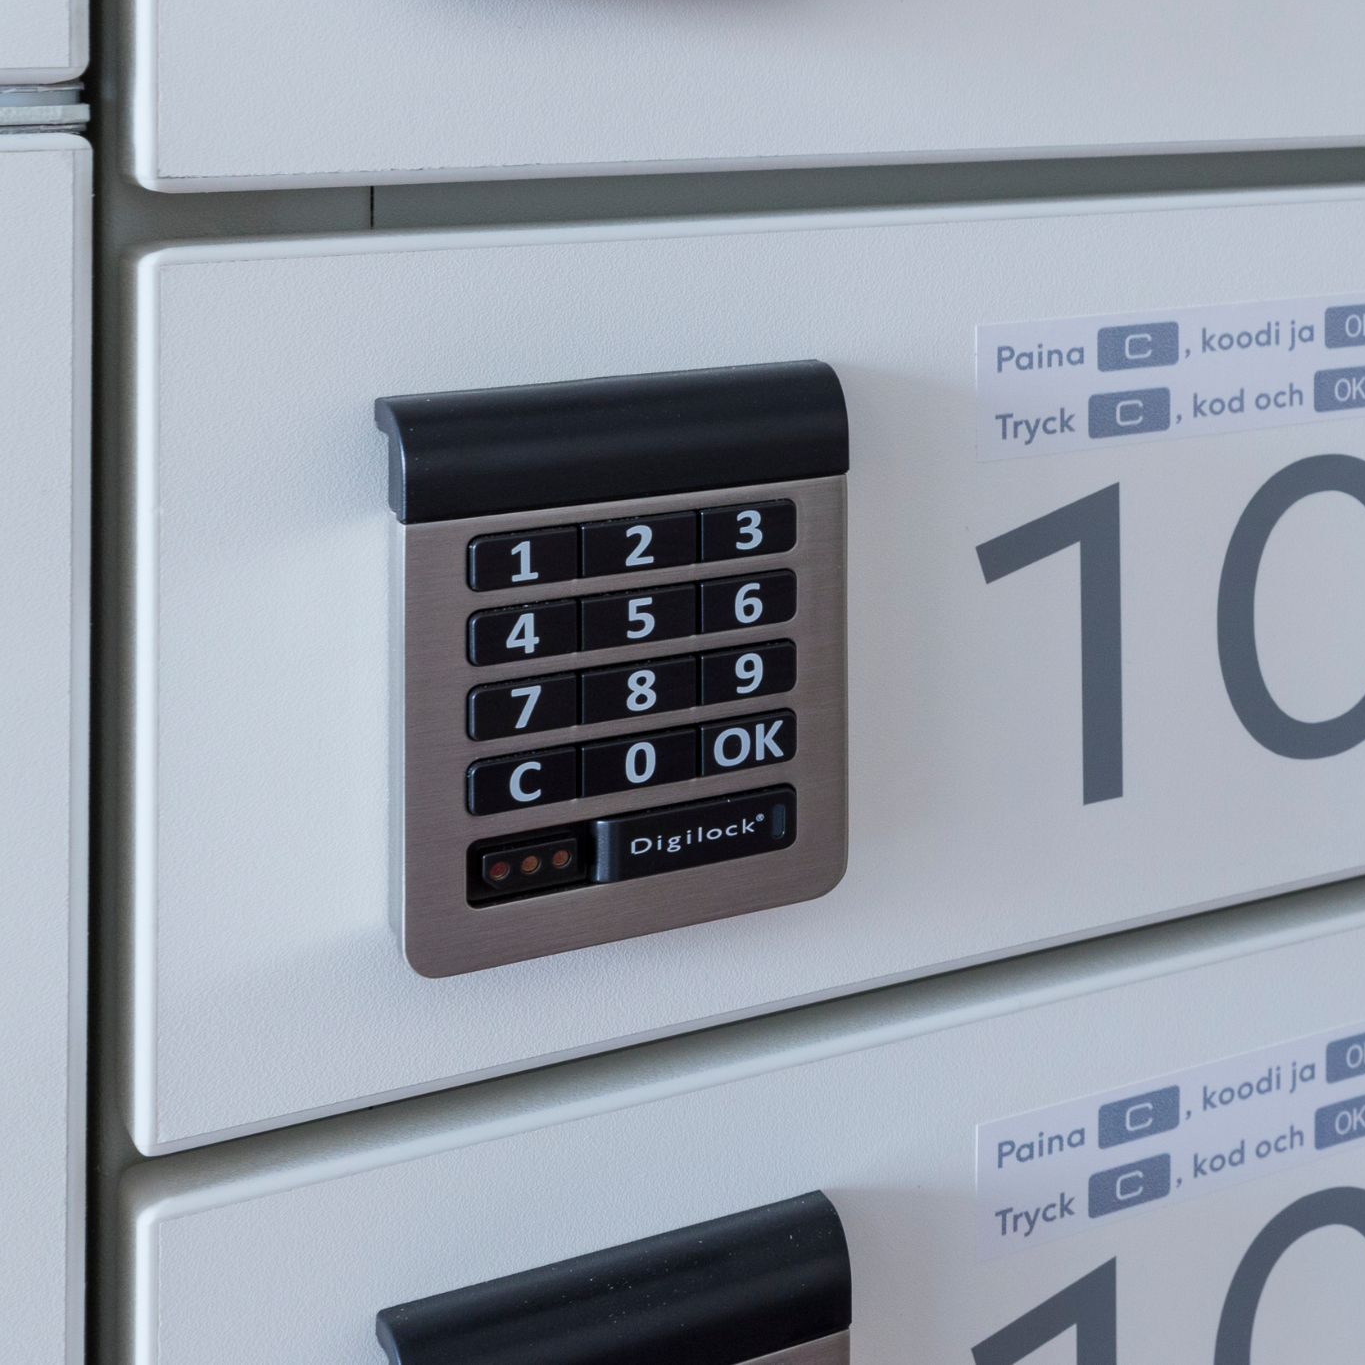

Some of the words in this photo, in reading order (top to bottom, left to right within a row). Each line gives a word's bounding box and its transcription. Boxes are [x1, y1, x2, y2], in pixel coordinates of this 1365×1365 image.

[997, 344, 1085, 373] Paina
[1201, 326, 1281, 353] koodi
[1288, 320, 1315, 351] ja
[995, 407, 1076, 445] Tryck
[1192, 390, 1246, 419] kod
[1254, 383, 1303, 411] och
[511, 540, 539, 581] 1
[625, 525, 654, 567] 2
[736, 510, 764, 550] 3
[506, 612, 539, 654] 4
[626, 598, 655, 638] 5
[735, 583, 764, 623] 6
[511, 686, 541, 729] 7
[626, 670, 657, 711] 8
[735, 653, 764, 694] 9
[509, 761, 542, 802] C
[625, 742, 656, 783] 0
[714, 720, 785, 767] OK
[997, 1127, 1086, 1168] Paina
[1203, 1066, 1282, 1110] koodi
[1289, 1059, 1316, 1092] ja
[995, 1193, 1075, 1237] Tryck
[1193, 1140, 1245, 1178] kod
[1255, 1126, 1304, 1159] och
